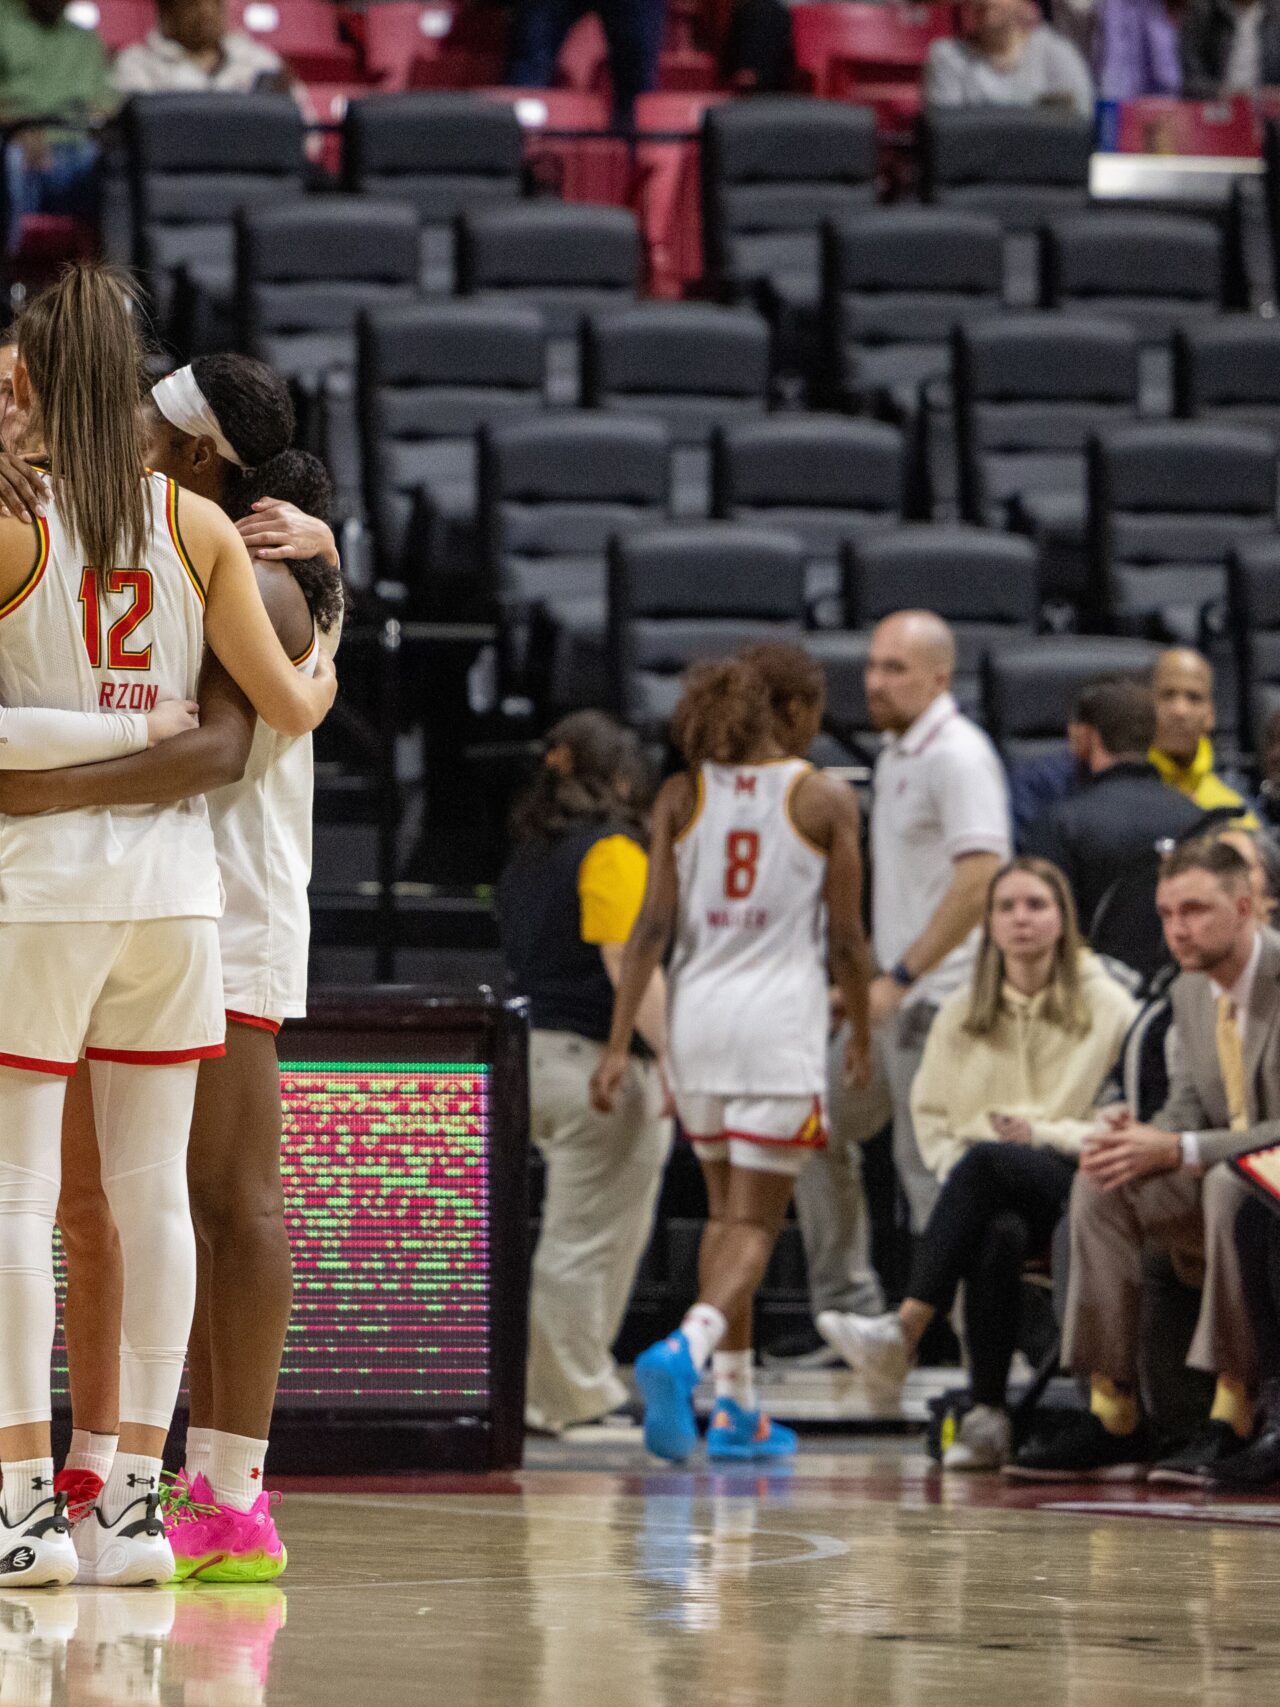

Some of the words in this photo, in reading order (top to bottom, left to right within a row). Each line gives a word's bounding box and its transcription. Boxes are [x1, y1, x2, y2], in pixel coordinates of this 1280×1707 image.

[78, 566, 154, 671] 12
[99, 681, 159, 710] RZON
[734, 774, 757, 796] M
[724, 830, 760, 899] 8
